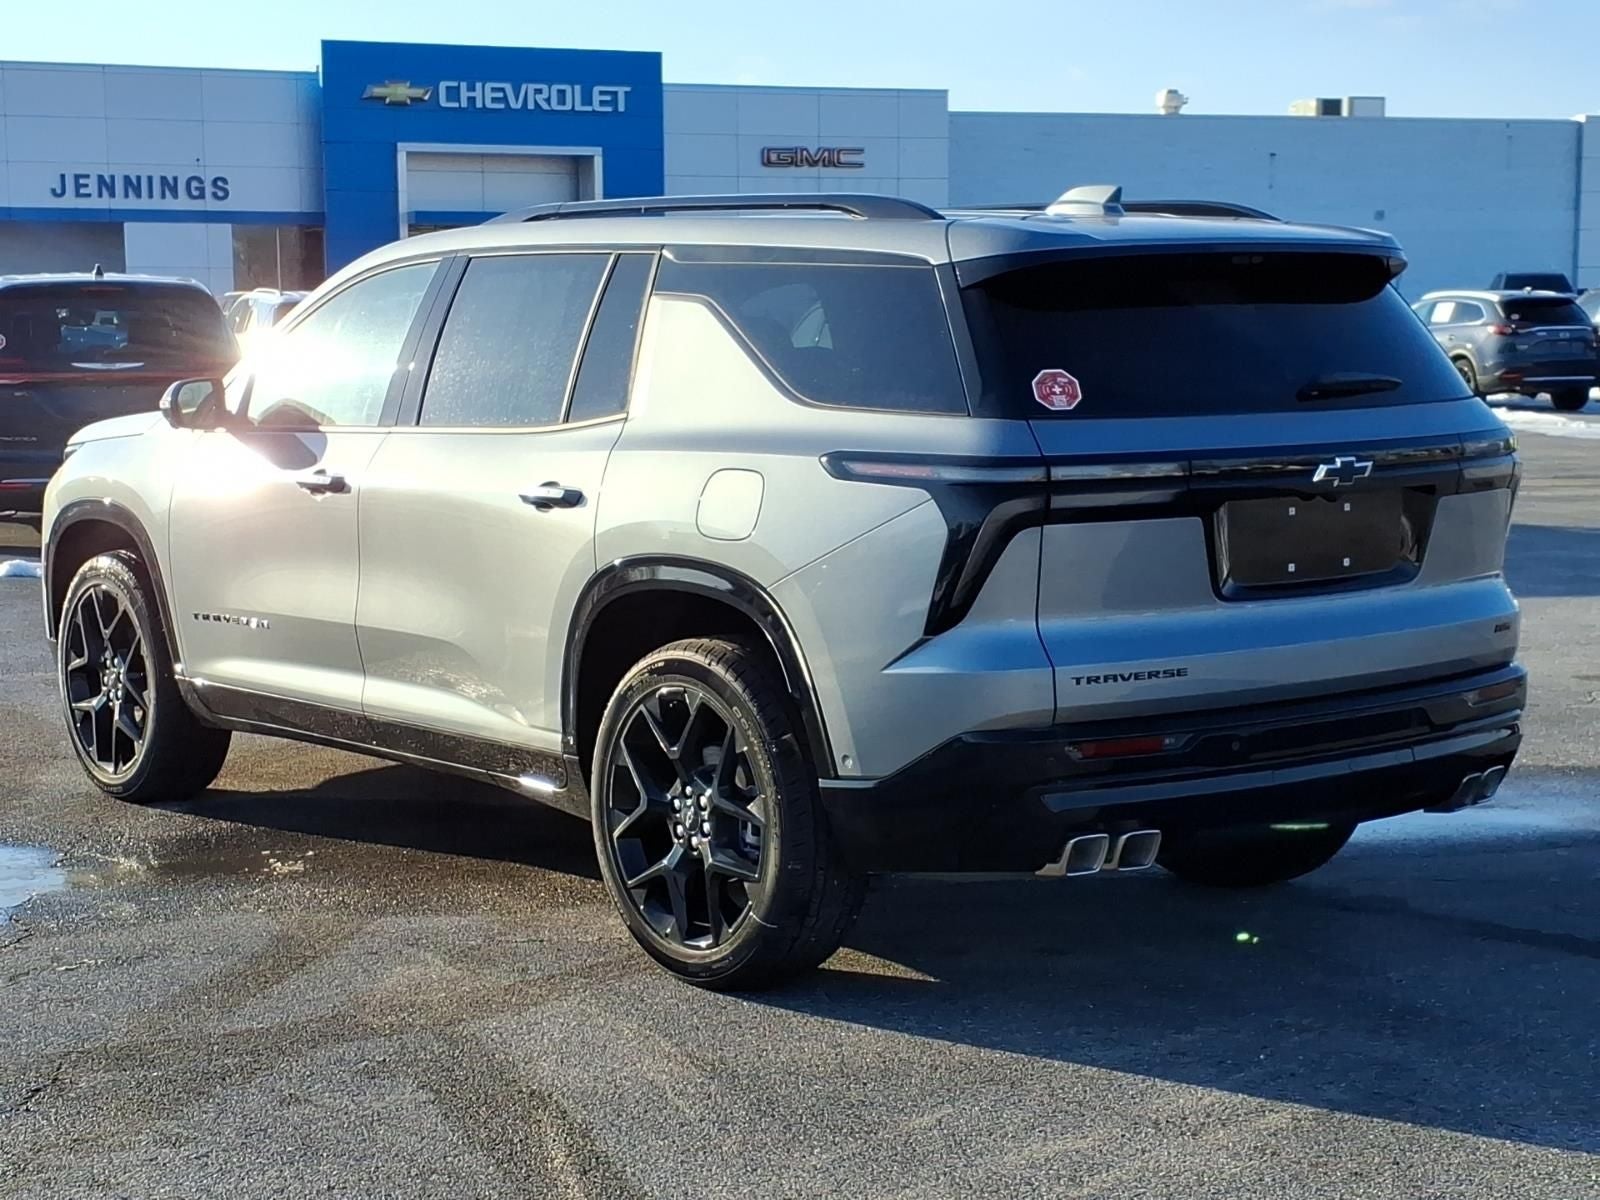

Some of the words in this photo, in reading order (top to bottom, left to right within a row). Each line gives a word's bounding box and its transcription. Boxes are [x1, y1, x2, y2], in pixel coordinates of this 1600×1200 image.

[438, 80, 632, 112] CHEVROLET
[761, 146, 864, 168] GMC
[50, 173, 230, 202] JENNINGS
[192, 612, 271, 630] TRAVE
[1070, 667, 1189, 686] TRAVERSE
